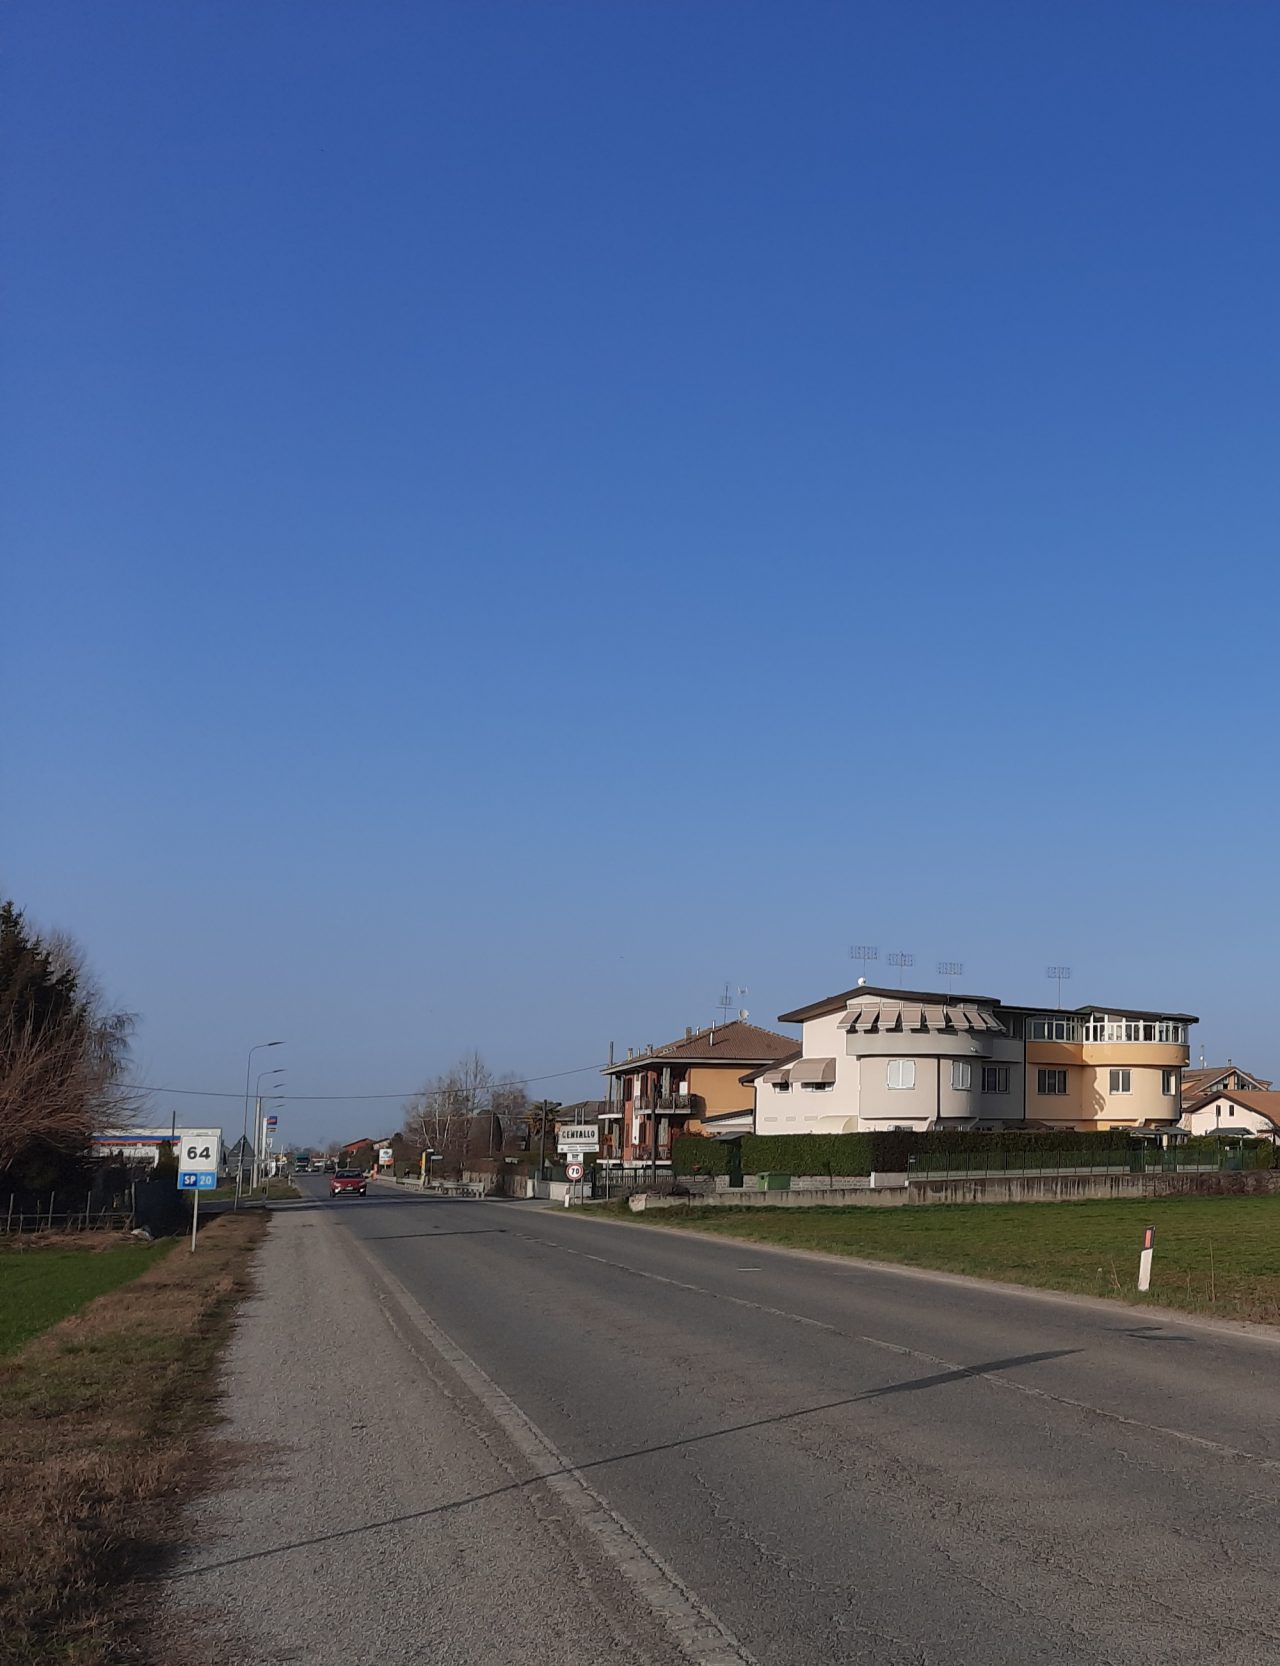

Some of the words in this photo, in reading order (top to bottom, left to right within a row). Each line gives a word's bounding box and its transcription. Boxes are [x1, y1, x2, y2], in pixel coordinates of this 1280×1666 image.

[561, 1130, 595, 1138] CENTALLO
[187, 1146, 211, 1160] 64
[184, 1176, 196, 1184] SP
[199, 1176, 212, 1185] 20
